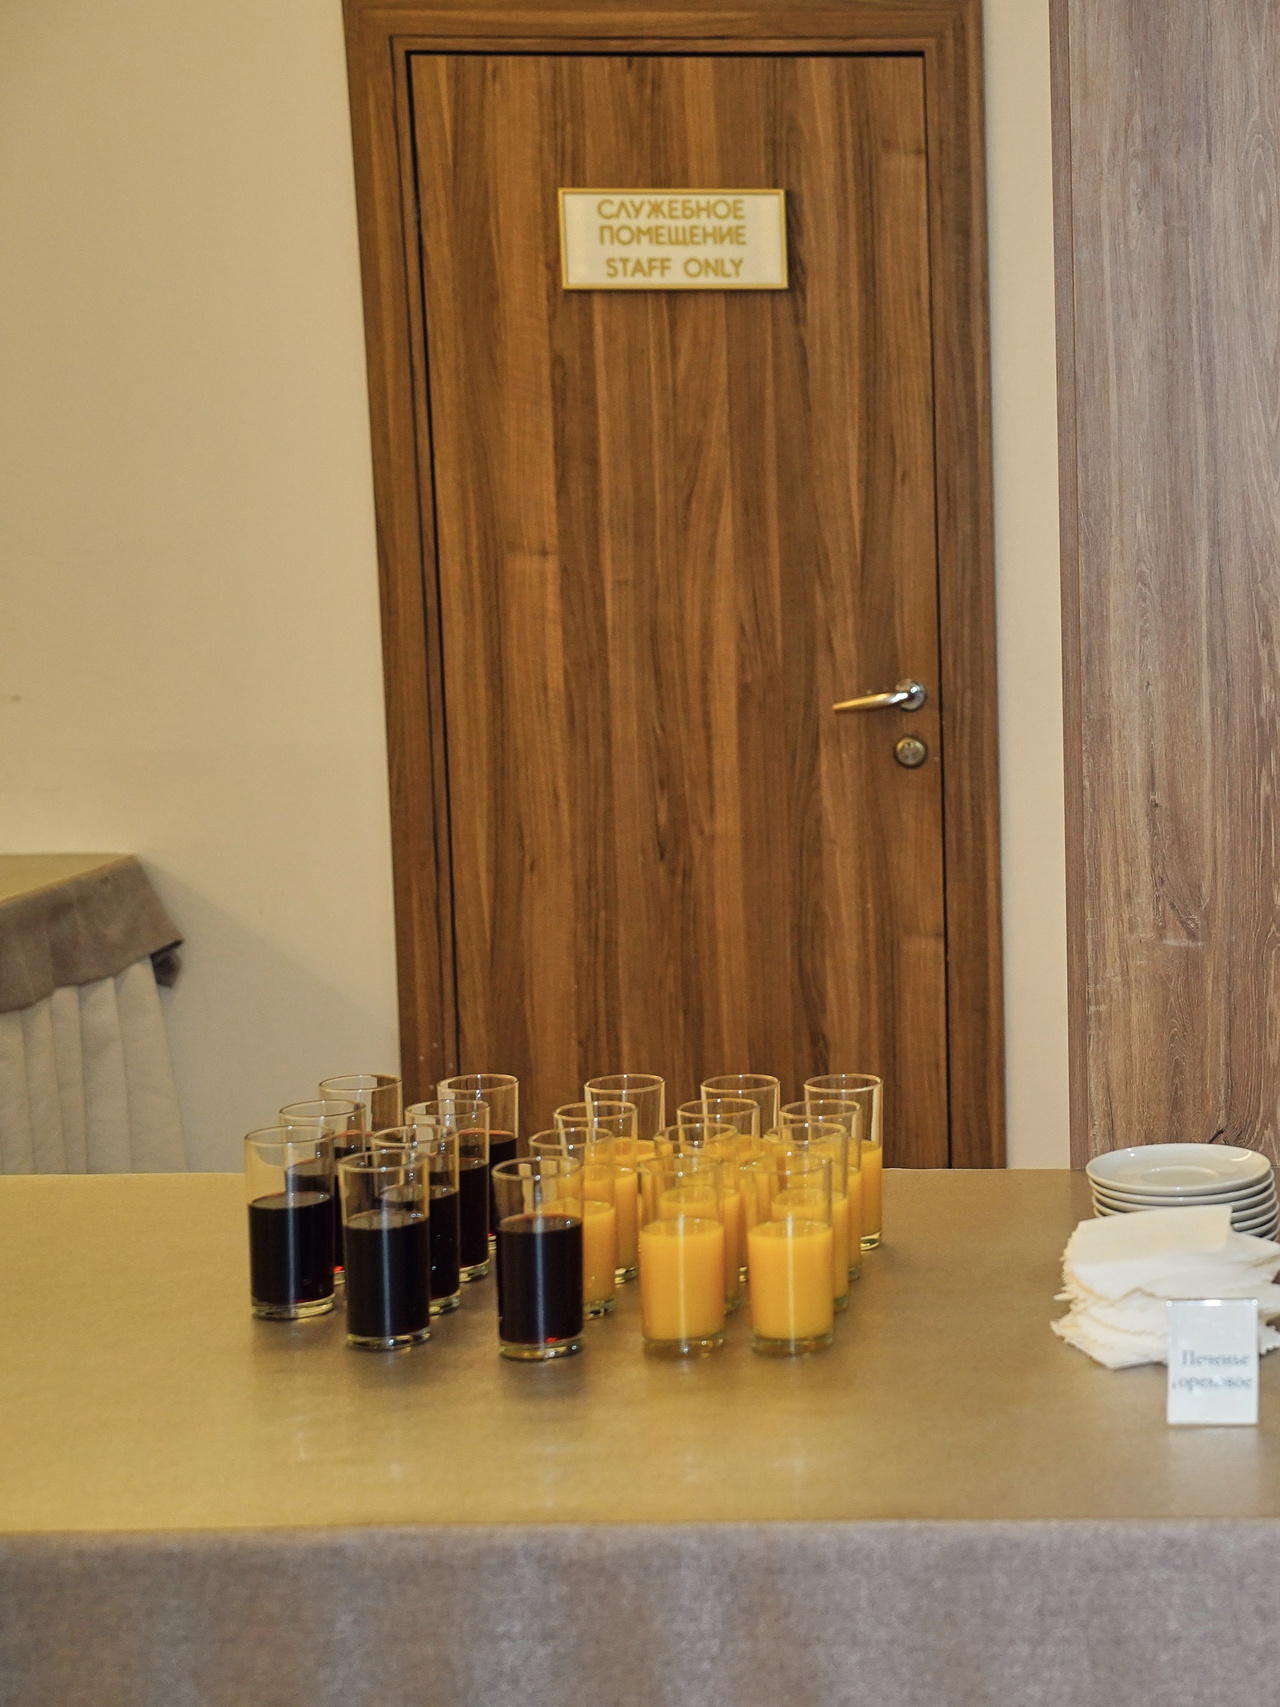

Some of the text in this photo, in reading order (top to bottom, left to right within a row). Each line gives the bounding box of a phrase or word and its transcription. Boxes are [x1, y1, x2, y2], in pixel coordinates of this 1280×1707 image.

[597, 199, 745, 220] СЛУЖЕБНОЕ
[600, 225, 746, 246] ПОМЕЩЕНИЕ
[605, 257, 744, 278] STAFF ONLY
